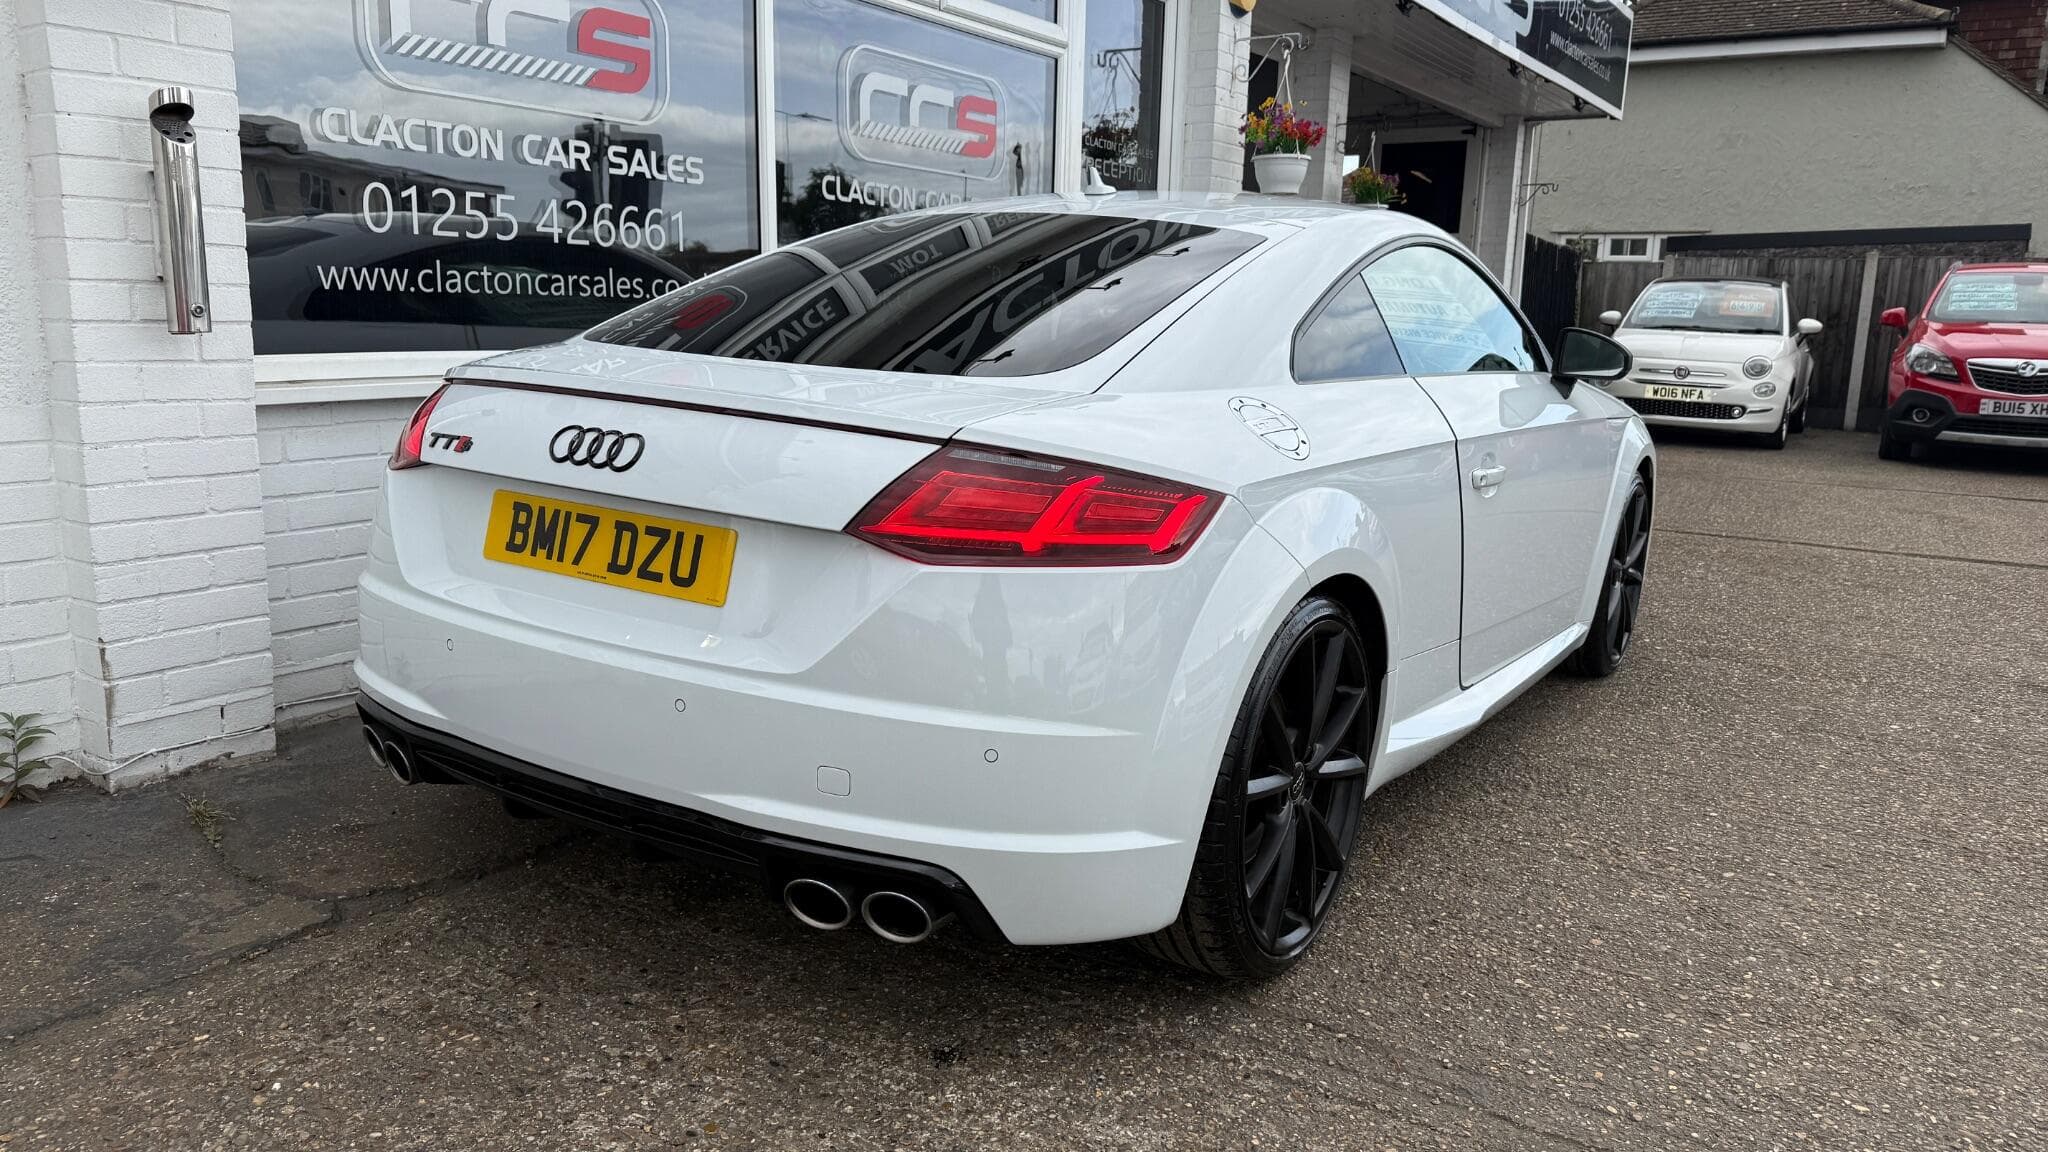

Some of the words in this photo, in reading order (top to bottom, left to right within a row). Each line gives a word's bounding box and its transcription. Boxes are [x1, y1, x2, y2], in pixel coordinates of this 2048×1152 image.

[1586, 9, 1613, 53] 426661
[859, 71, 997, 159] CCS
[320, 106, 505, 161] CLACTON
[522, 134, 592, 172] CAR
[607, 145, 704, 184] SALES
[1084, 133, 1117, 152] CLACTON
[1085, 154, 1153, 185] RECEPTION
[821, 174, 917, 211] CLACTON
[361, 181, 519, 241] 01255
[535, 198, 685, 252] 426661
[316, 259, 707, 300] www.clactoncarsales.co
[1652, 386, 1679, 399] WO16
[1681, 388, 1704, 401] NFA
[1992, 401, 2026, 415] BU15
[504, 500, 601, 567] BM17
[606, 519, 705, 588] DZU
